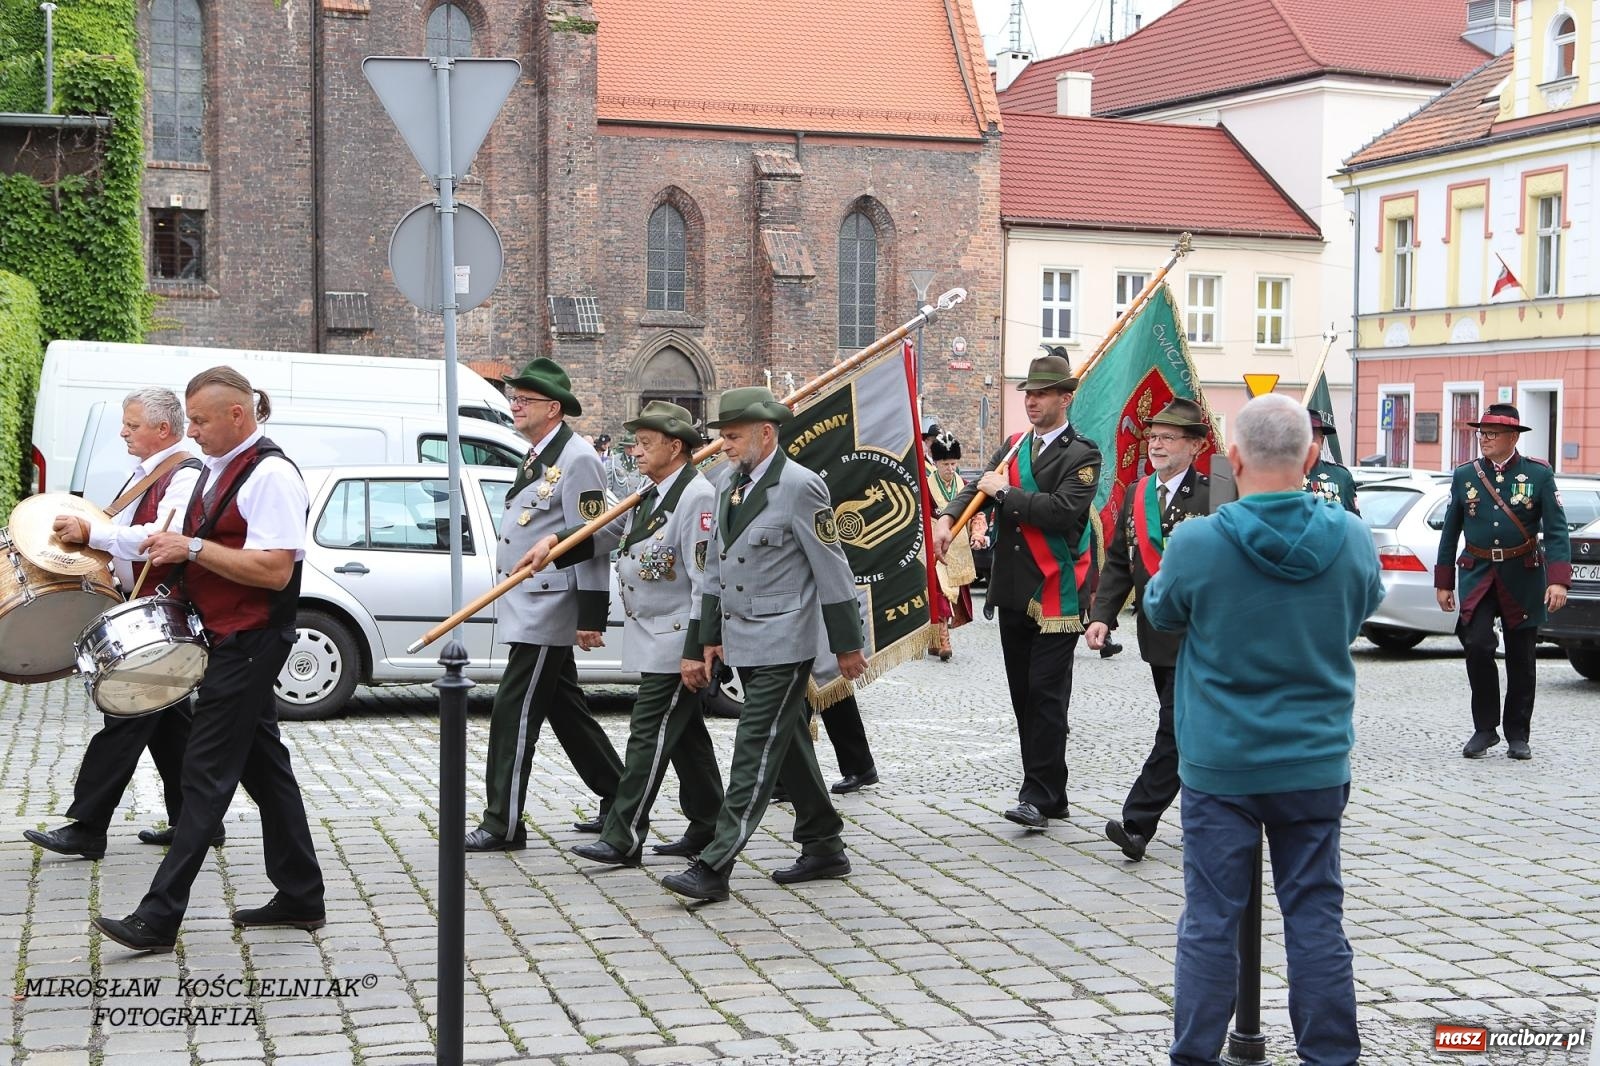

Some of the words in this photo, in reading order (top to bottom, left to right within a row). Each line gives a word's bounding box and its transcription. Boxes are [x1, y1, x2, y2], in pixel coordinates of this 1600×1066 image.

[1384, 400, 1392, 415] P
[841, 452, 919, 494] RACIBORSKIE
[855, 572, 885, 585] CKIE
[885, 590, 930, 622] RAZ
